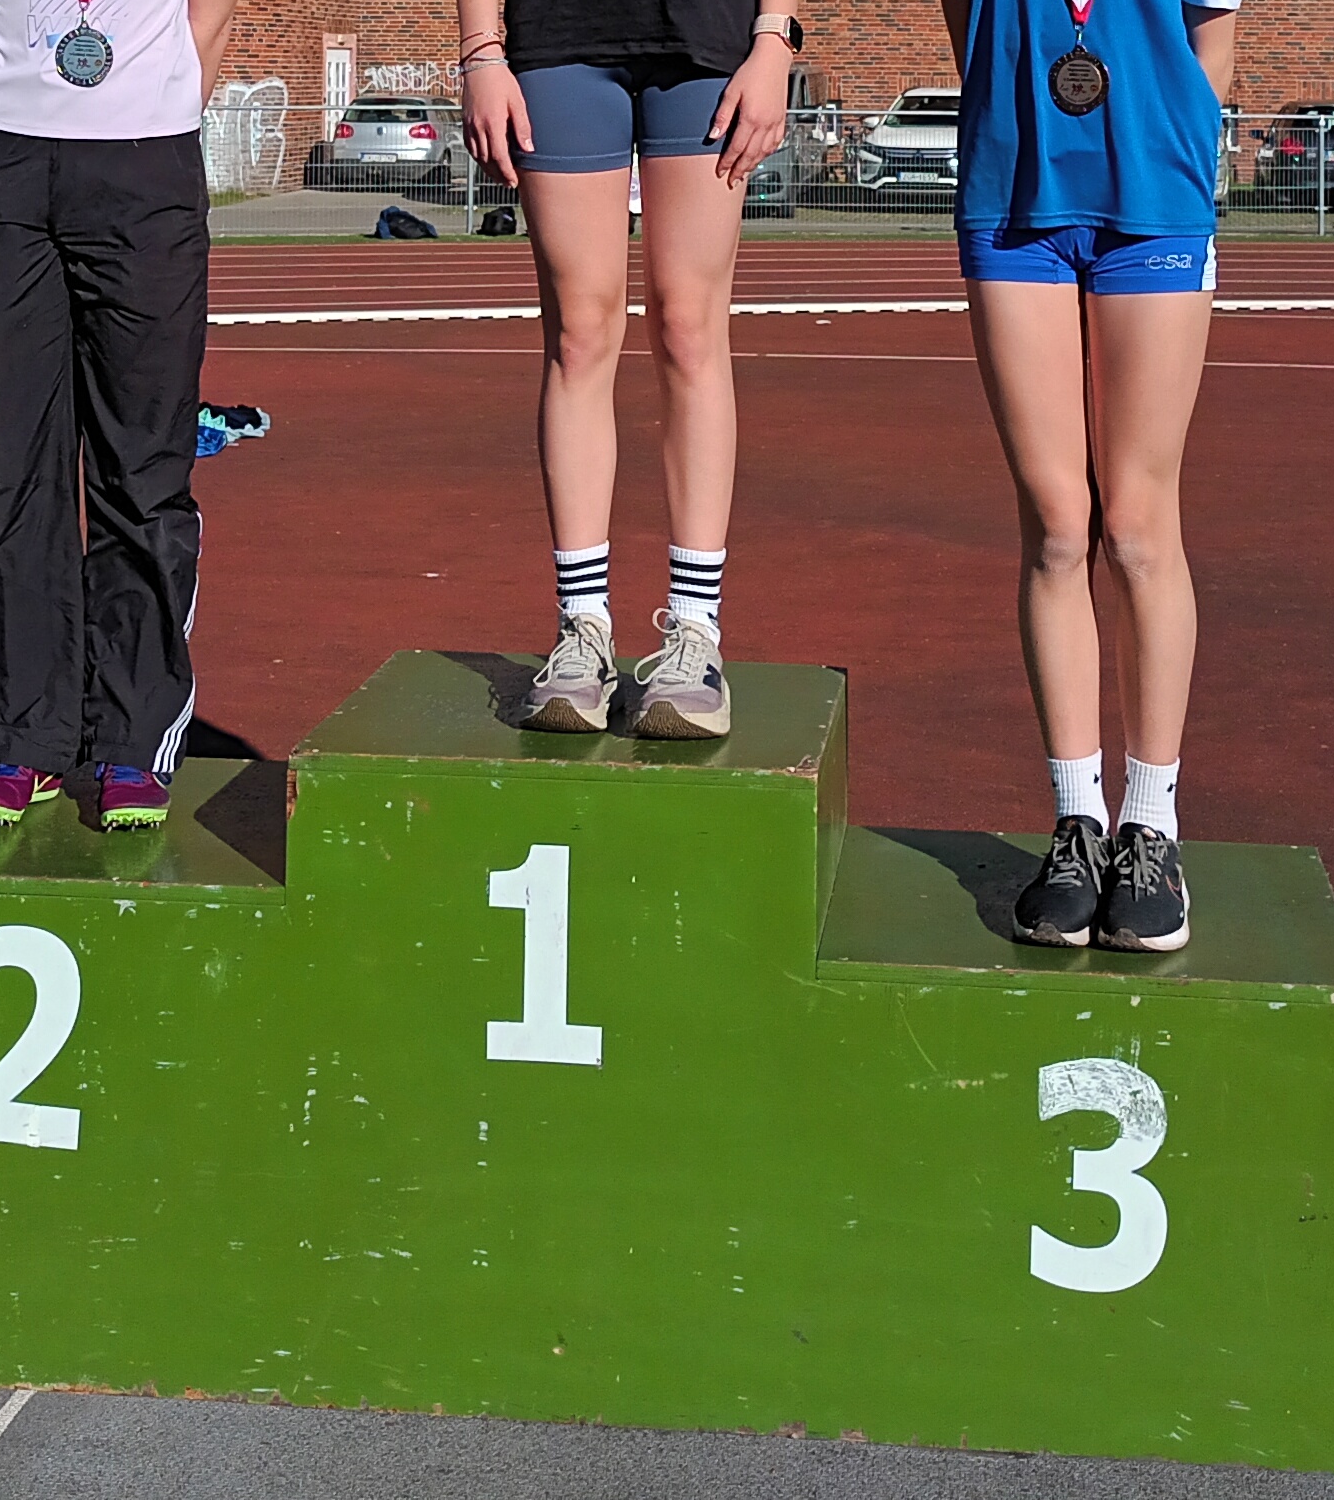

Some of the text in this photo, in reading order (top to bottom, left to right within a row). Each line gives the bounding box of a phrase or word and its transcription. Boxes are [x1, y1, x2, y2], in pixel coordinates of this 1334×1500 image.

[27, 15, 119, 49] WN
[486, 844, 603, 1066] 1
[1030, 1057, 1168, 1293] 3
